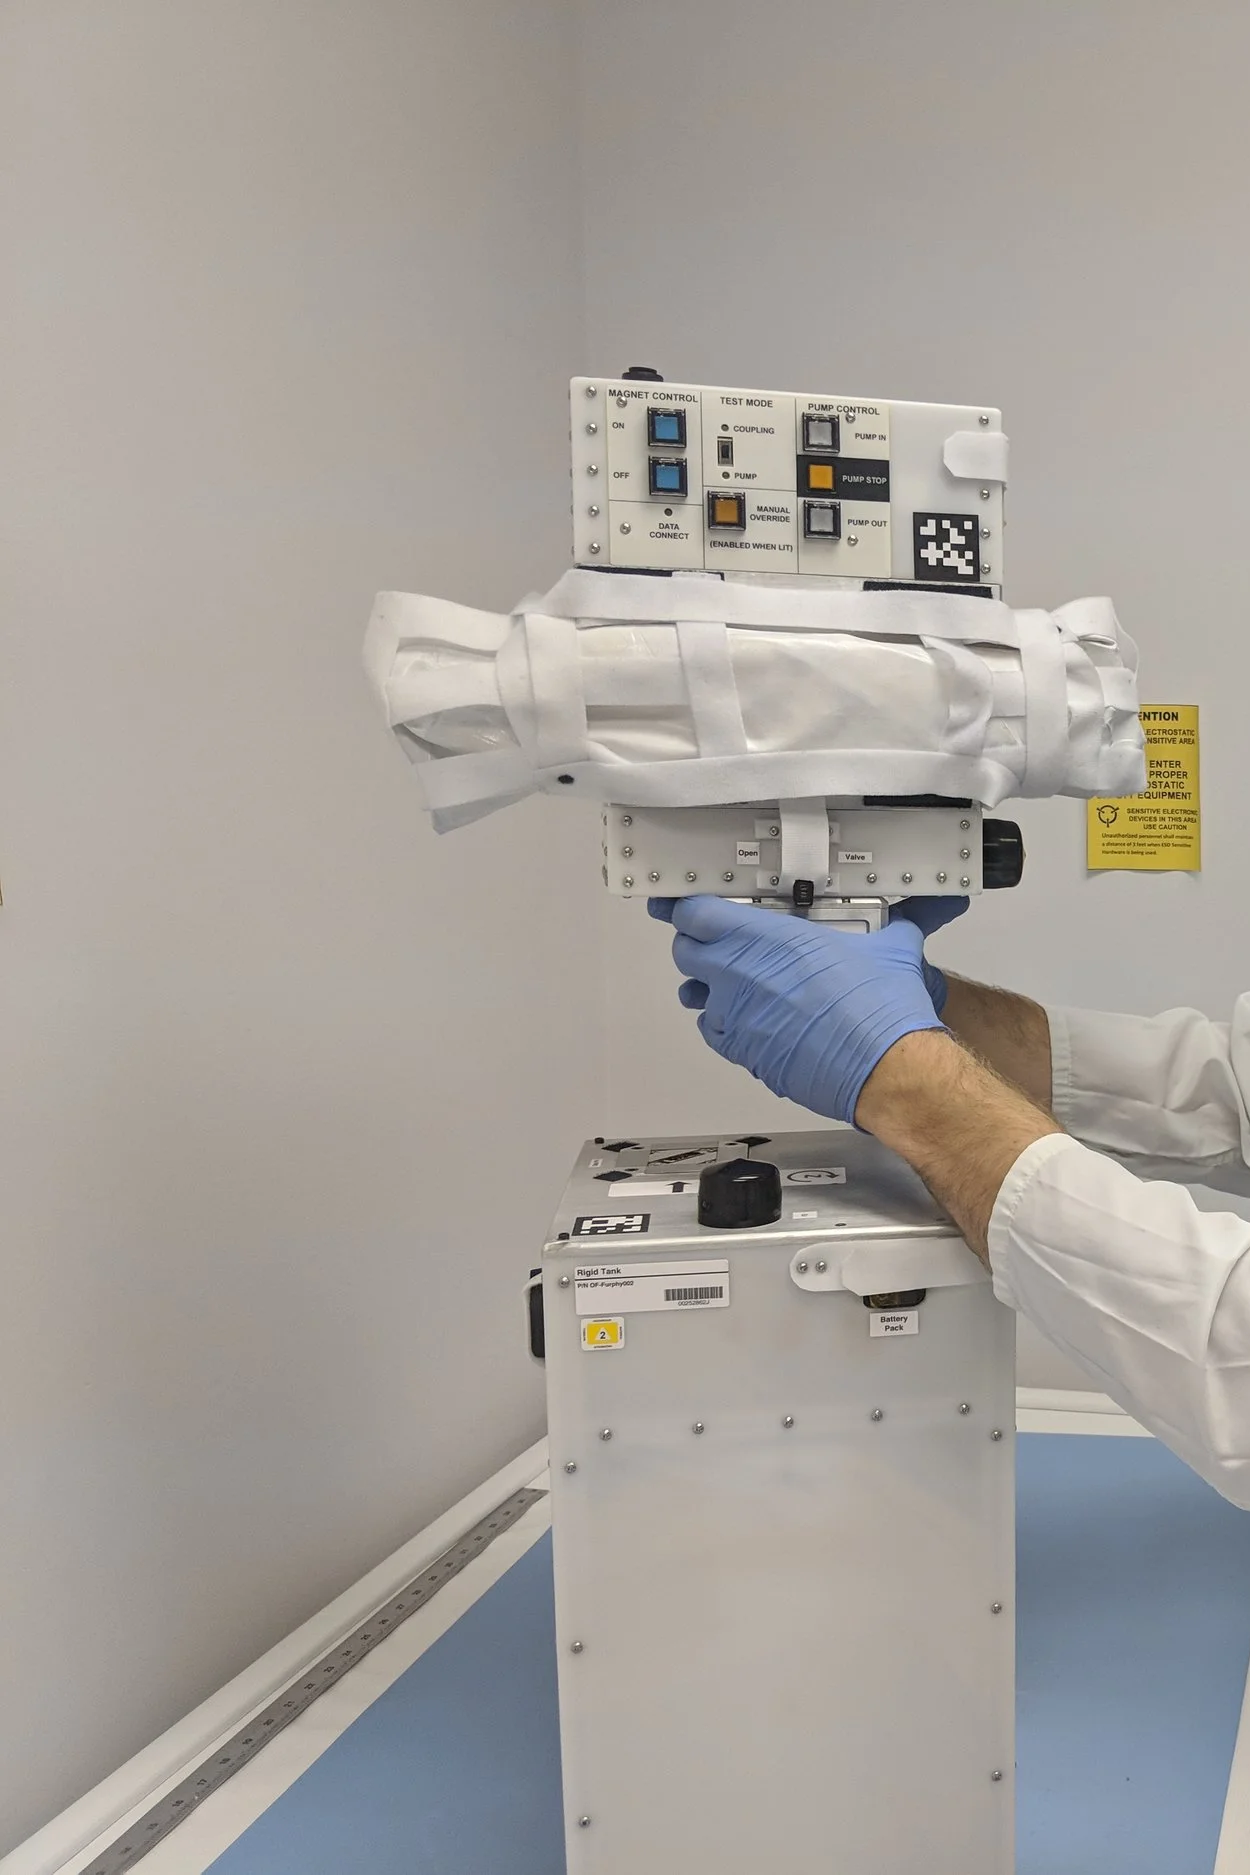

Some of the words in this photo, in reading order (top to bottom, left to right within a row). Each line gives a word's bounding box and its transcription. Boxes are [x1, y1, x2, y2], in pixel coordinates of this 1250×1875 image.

[608, 389, 649, 400] MAGNET
[652, 392, 698, 403] CONTROL
[720, 396, 743, 406] TEST
[746, 398, 774, 408] MODE
[808, 403, 834, 412] PUMP
[836, 405, 880, 416] CONTROL
[733, 425, 775, 435] COUPLING
[855, 432, 877, 441] PUMP
[734, 472, 757, 480] PUMP
[842, 475, 865, 483] PUMP
[866, 476, 888, 485] STOP
[756, 505, 791, 514] MANUAL
[750, 514, 791, 523] OVERRIDE
[649, 532, 690, 540] CONNECT
[709, 541, 751, 550] (ENABLED
[752, 542, 777, 551] WHEN
[778, 544, 793, 552] LIT)
[1138, 712, 1179, 721] ENTION
[1149, 760, 1182, 768] ENTER
[1149, 771, 1188, 779] PROPER
[1138, 792, 1192, 800] EQUIPMENT
[738, 849, 758, 858] Open
[576, 1268, 598, 1277] Rigid
[600, 1331, 606, 1339] 2
